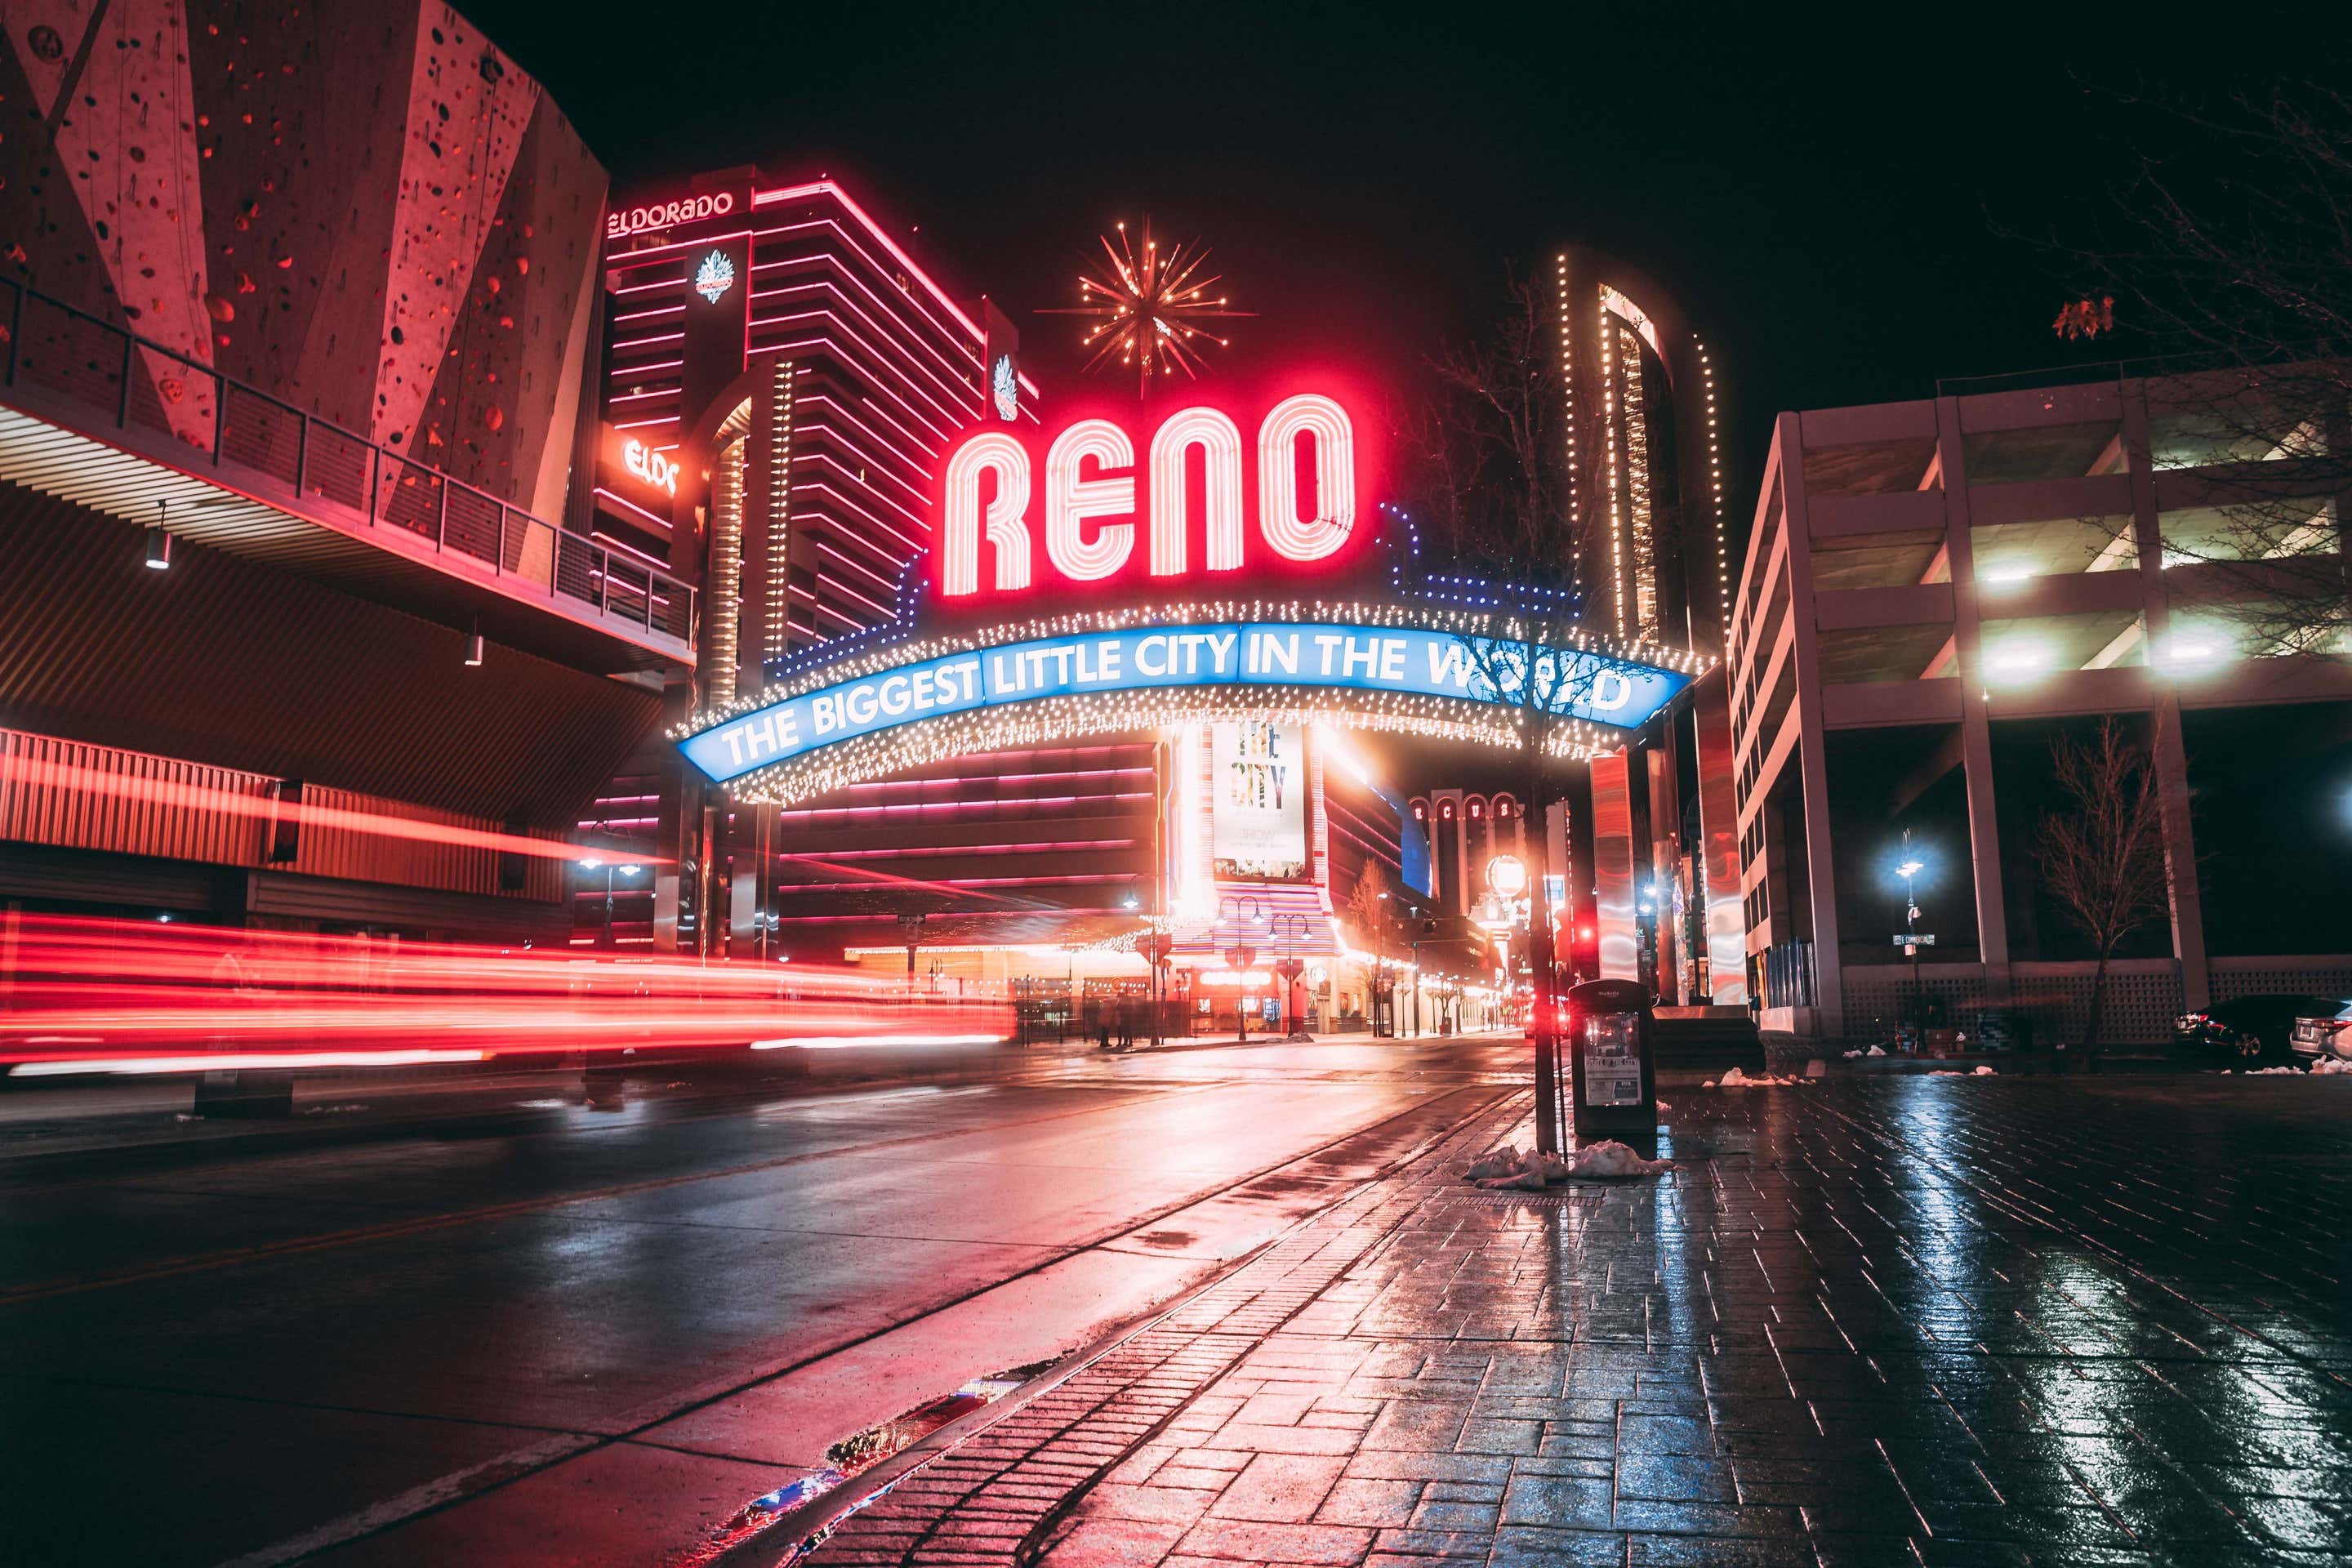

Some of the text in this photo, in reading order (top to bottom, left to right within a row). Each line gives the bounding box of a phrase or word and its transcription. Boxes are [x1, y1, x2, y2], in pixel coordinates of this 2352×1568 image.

[608, 192, 733, 235] ELDORADO
[943, 394, 1356, 596] RENO
[721, 709, 800, 766] THE
[812, 661, 978, 735] BIGGEST
[994, 640, 1120, 694] LITTLE
[1134, 634, 1237, 676] CITY
[1249, 633, 1300, 674] IN
[1314, 635, 1406, 679] THE
[1231, 763, 1286, 808] CITY
